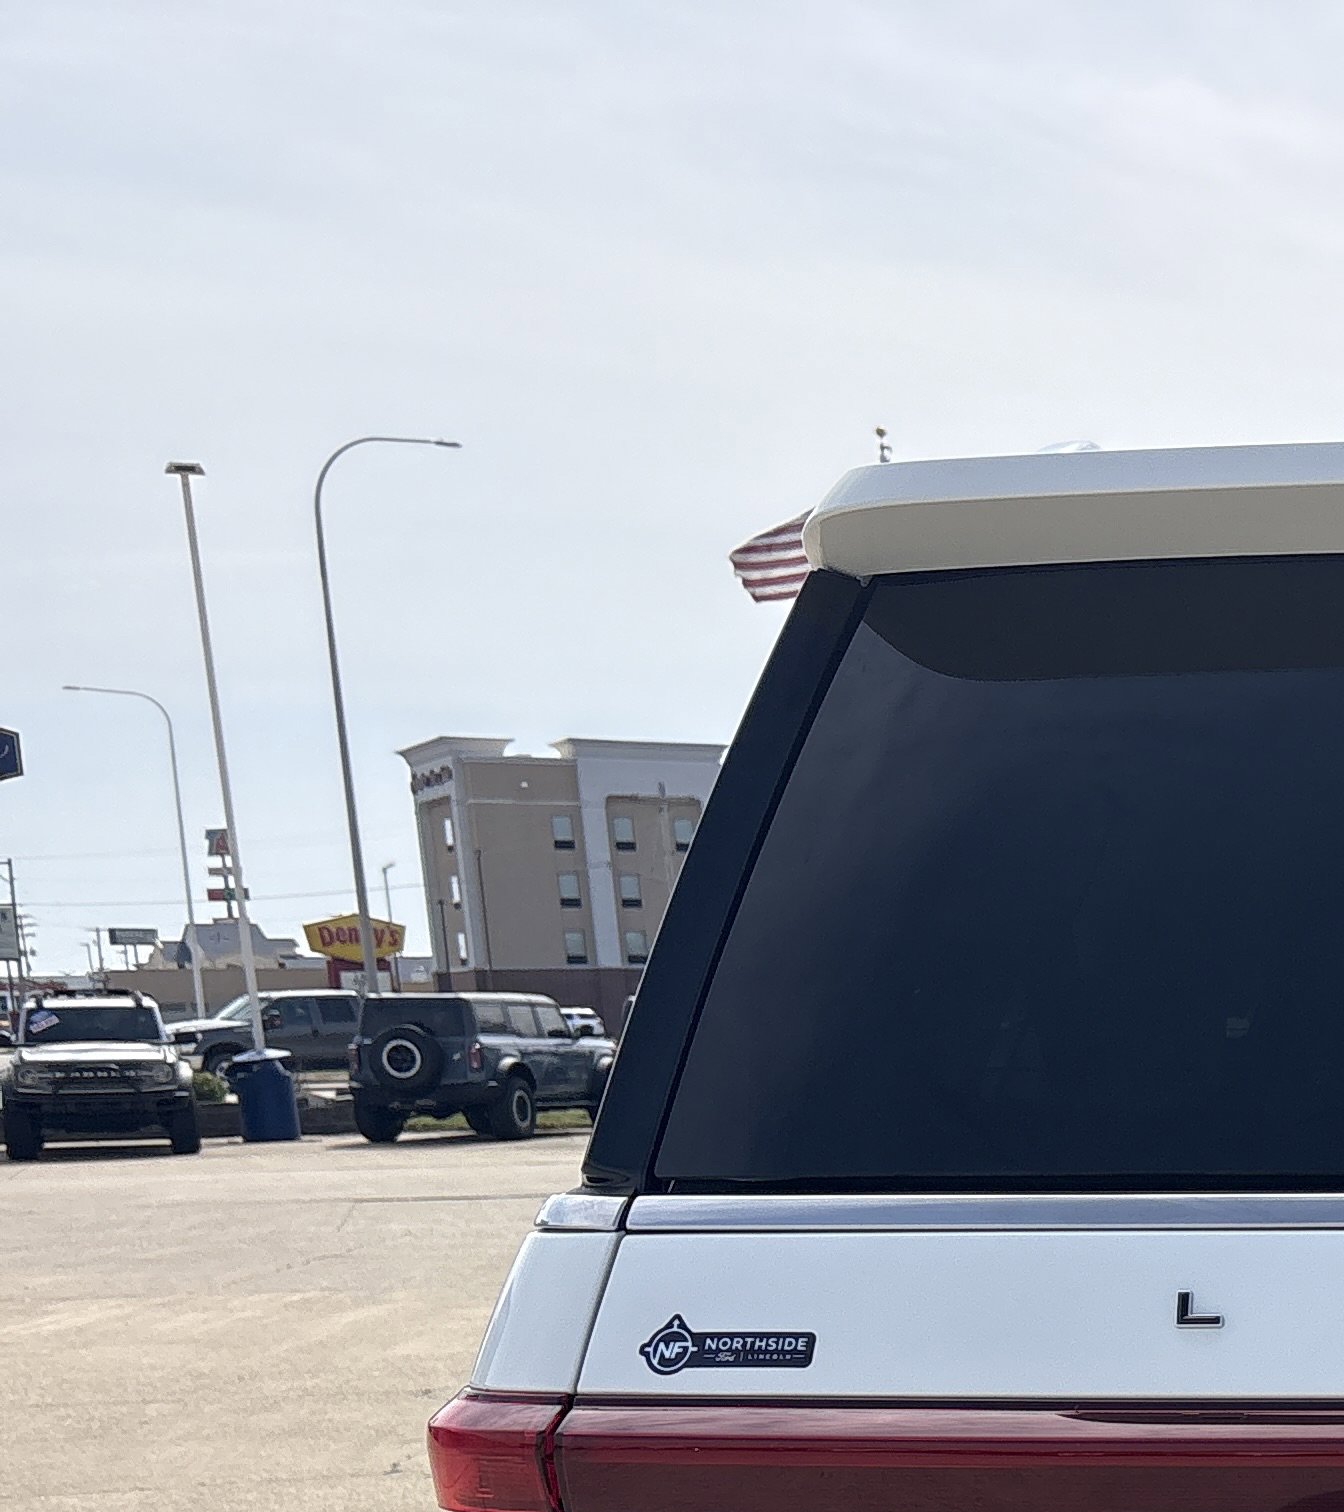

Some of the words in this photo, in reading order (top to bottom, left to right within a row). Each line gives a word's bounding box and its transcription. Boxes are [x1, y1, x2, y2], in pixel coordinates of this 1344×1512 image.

[318, 925, 400, 948] Deny's
[653, 1341, 692, 1365] NF
[704, 1337, 808, 1351] NORTHSIDE
[714, 1351, 736, 1362] Ford
